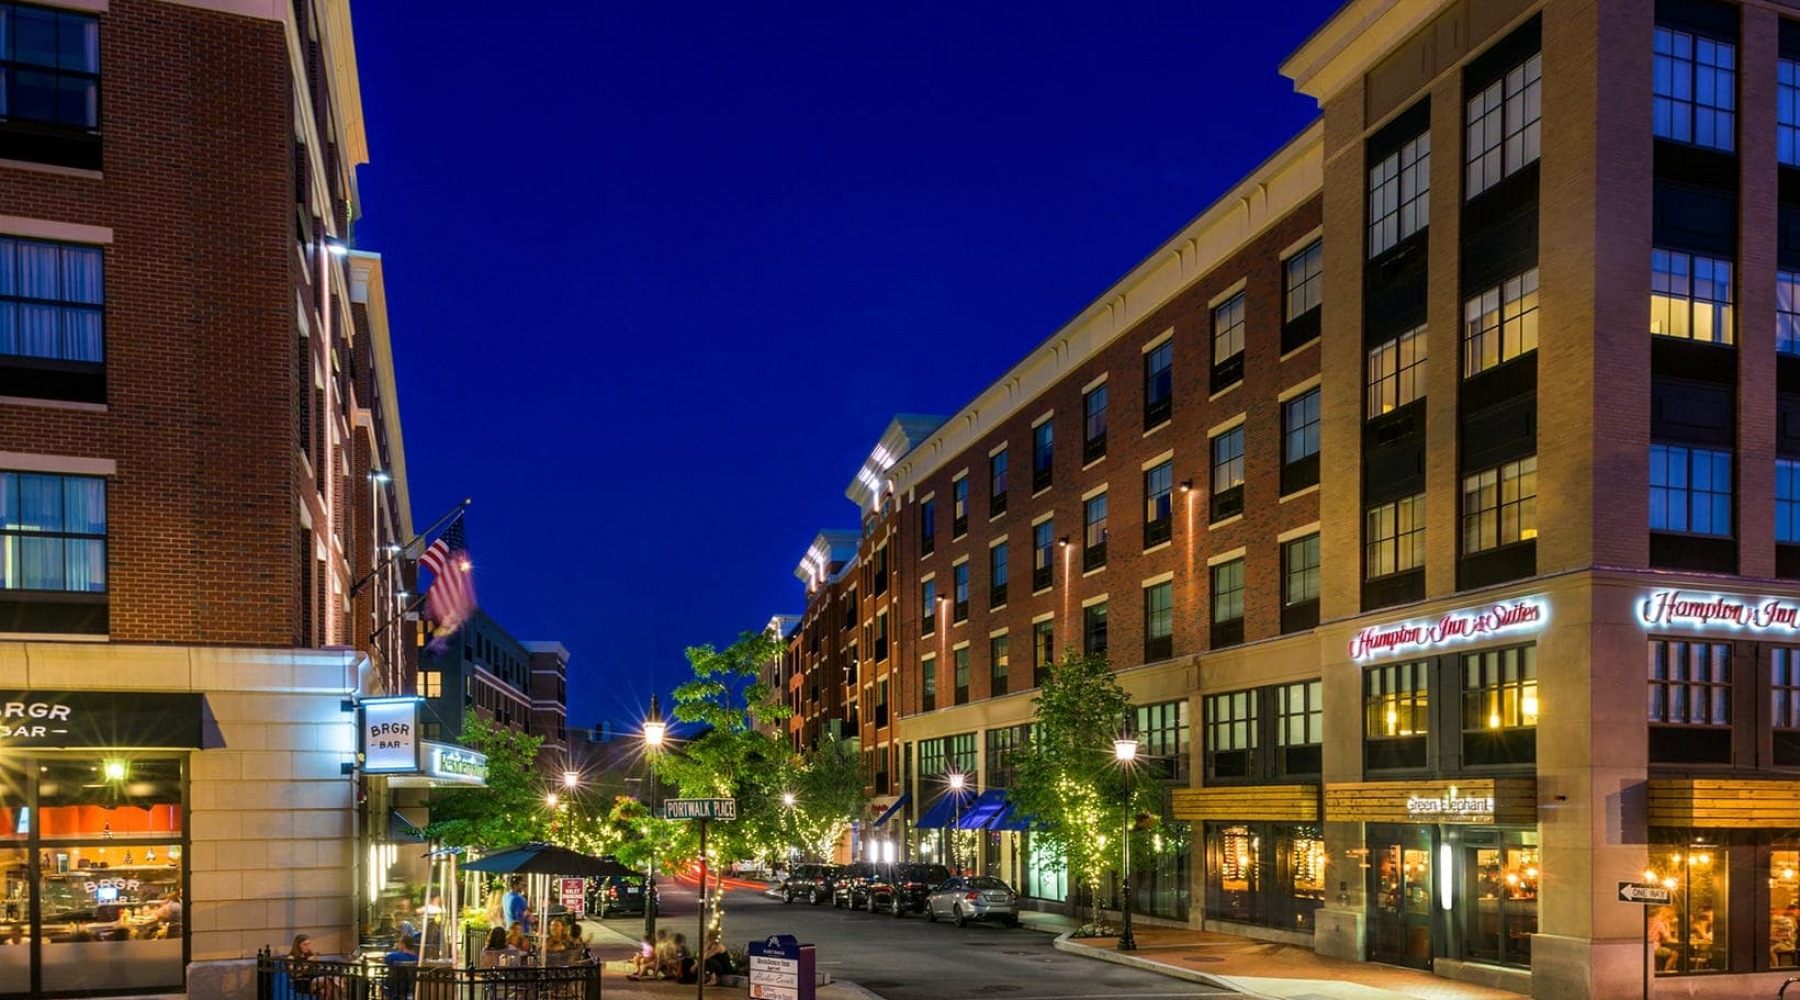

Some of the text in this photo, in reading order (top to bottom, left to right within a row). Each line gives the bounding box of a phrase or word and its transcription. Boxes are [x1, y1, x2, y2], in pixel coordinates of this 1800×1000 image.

[1642, 591, 1800, 629] Hampton Inn
[1349, 625, 1430, 660] Hampton
[1430, 613, 1476, 643] Inn
[1486, 602, 1541, 630] Suites
[0, 701, 71, 721] RGR
[371, 722, 410, 738] BRGR
[380, 741, 400, 749] BAR
[667, 800, 734, 817] PORTWALK PLACE
[1407, 786, 1494, 814] Green Elephant
[83, 878, 140, 893] BRGR
[1633, 888, 1666, 898] ONE WAY
